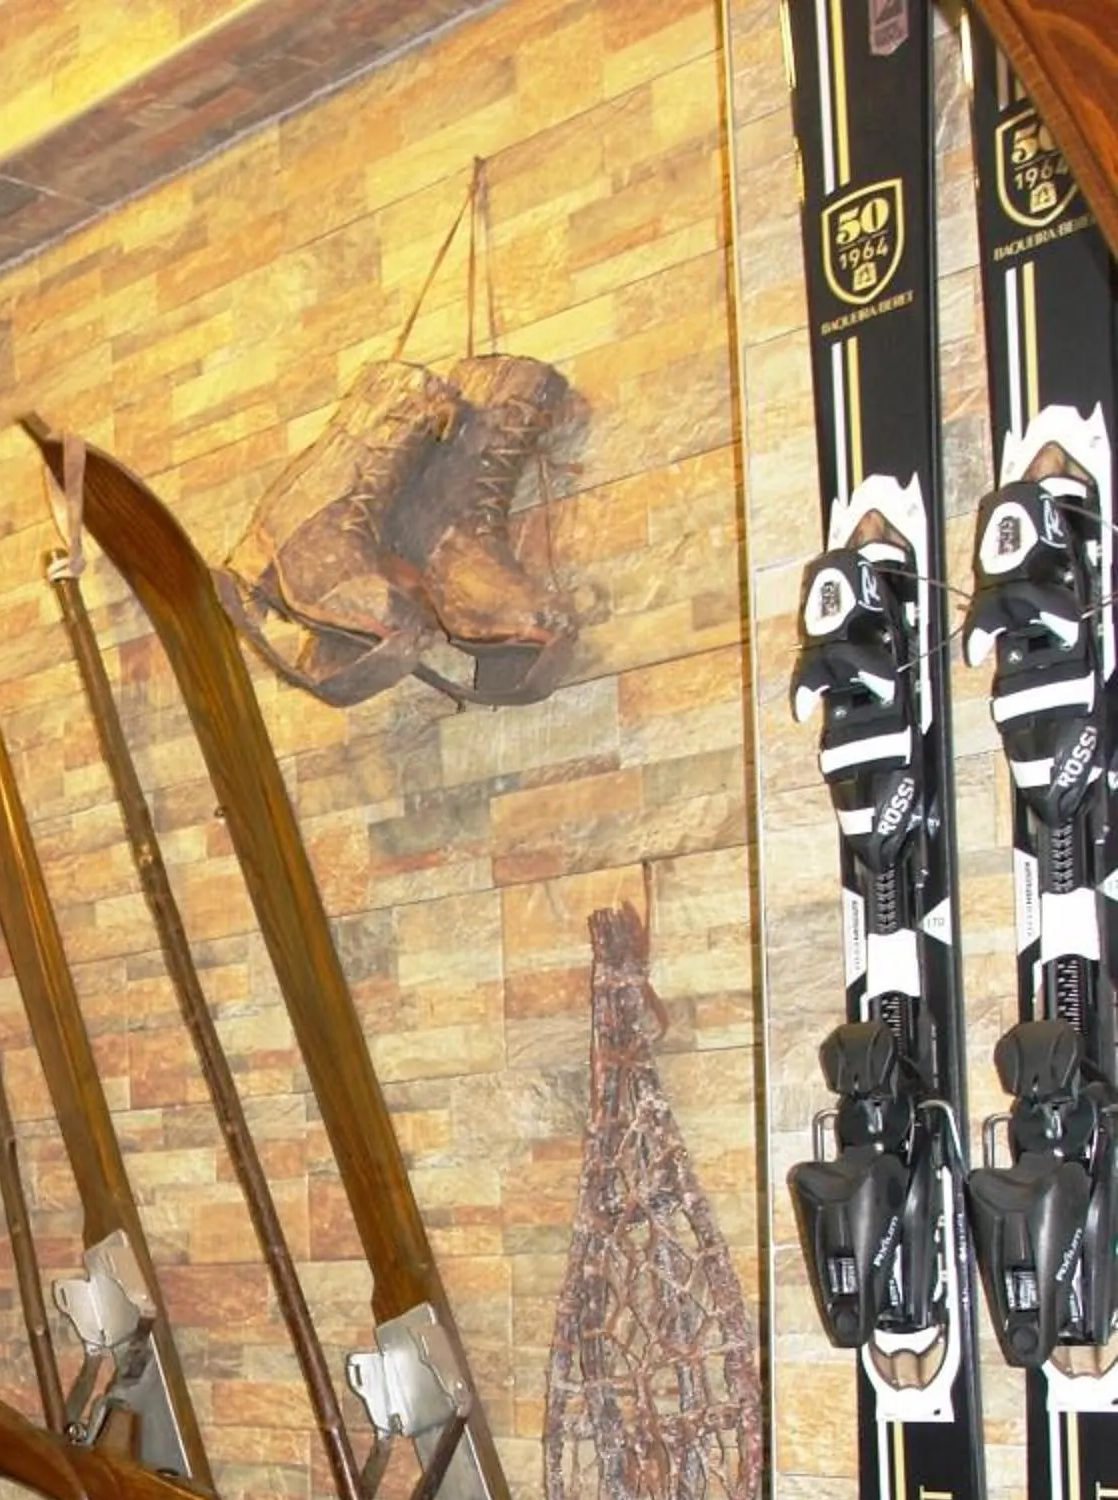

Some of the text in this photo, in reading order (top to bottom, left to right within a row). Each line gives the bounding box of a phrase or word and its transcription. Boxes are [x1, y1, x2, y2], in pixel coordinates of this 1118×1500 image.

[835, 196, 891, 245] 50
[838, 235, 889, 270] 1964
[1057, 725, 1098, 790] ROSSI
[877, 777, 915, 836] ROSSI
